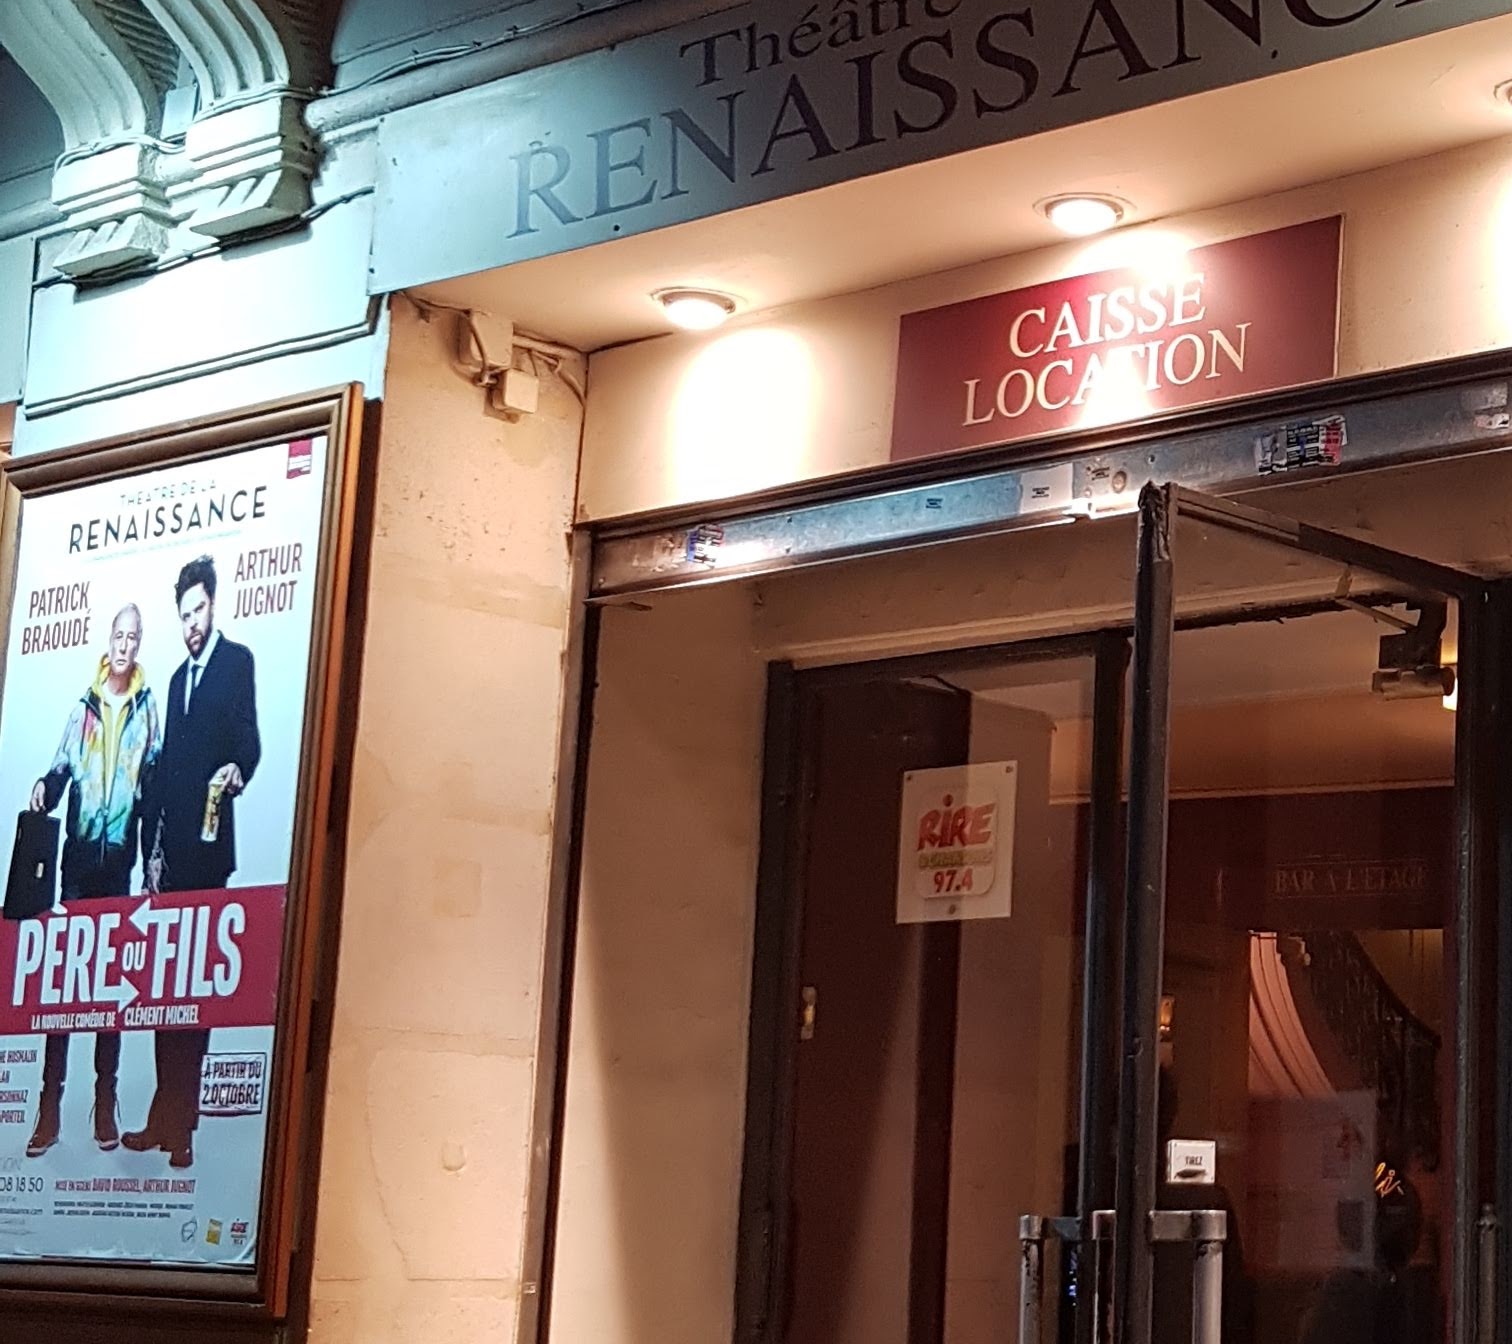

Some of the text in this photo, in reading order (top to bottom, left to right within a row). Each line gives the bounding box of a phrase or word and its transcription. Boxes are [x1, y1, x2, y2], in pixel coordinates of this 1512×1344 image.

[1009, 271, 1207, 358] CAISSE
[963, 322, 1252, 427] LOCATION
[69, 485, 267, 554] RENAISSANCE
[234, 542, 303, 583] ARTHUR
[29, 581, 91, 619] PATRICK
[233, 580, 298, 620] JUGNOT
[22, 608, 92, 656] BRAOUDÉ
[933, 868, 974, 893] 97.4
[12, 902, 246, 1006] PÈRE OU FILS
[31, 1015, 41, 1029] LA
[106, 1011, 116, 1027] DE
[124, 1002, 166, 1026] CLÉMENT
[166, 1004, 199, 1024] MICHEL
[212, 1061, 246, 1078] PARTIR
[248, 1061, 262, 1078] DU
[202, 1083, 261, 1105] 2 OCTOBRE
[16, 1176, 26, 1193] 18
[28, 1176, 44, 1193] 50
